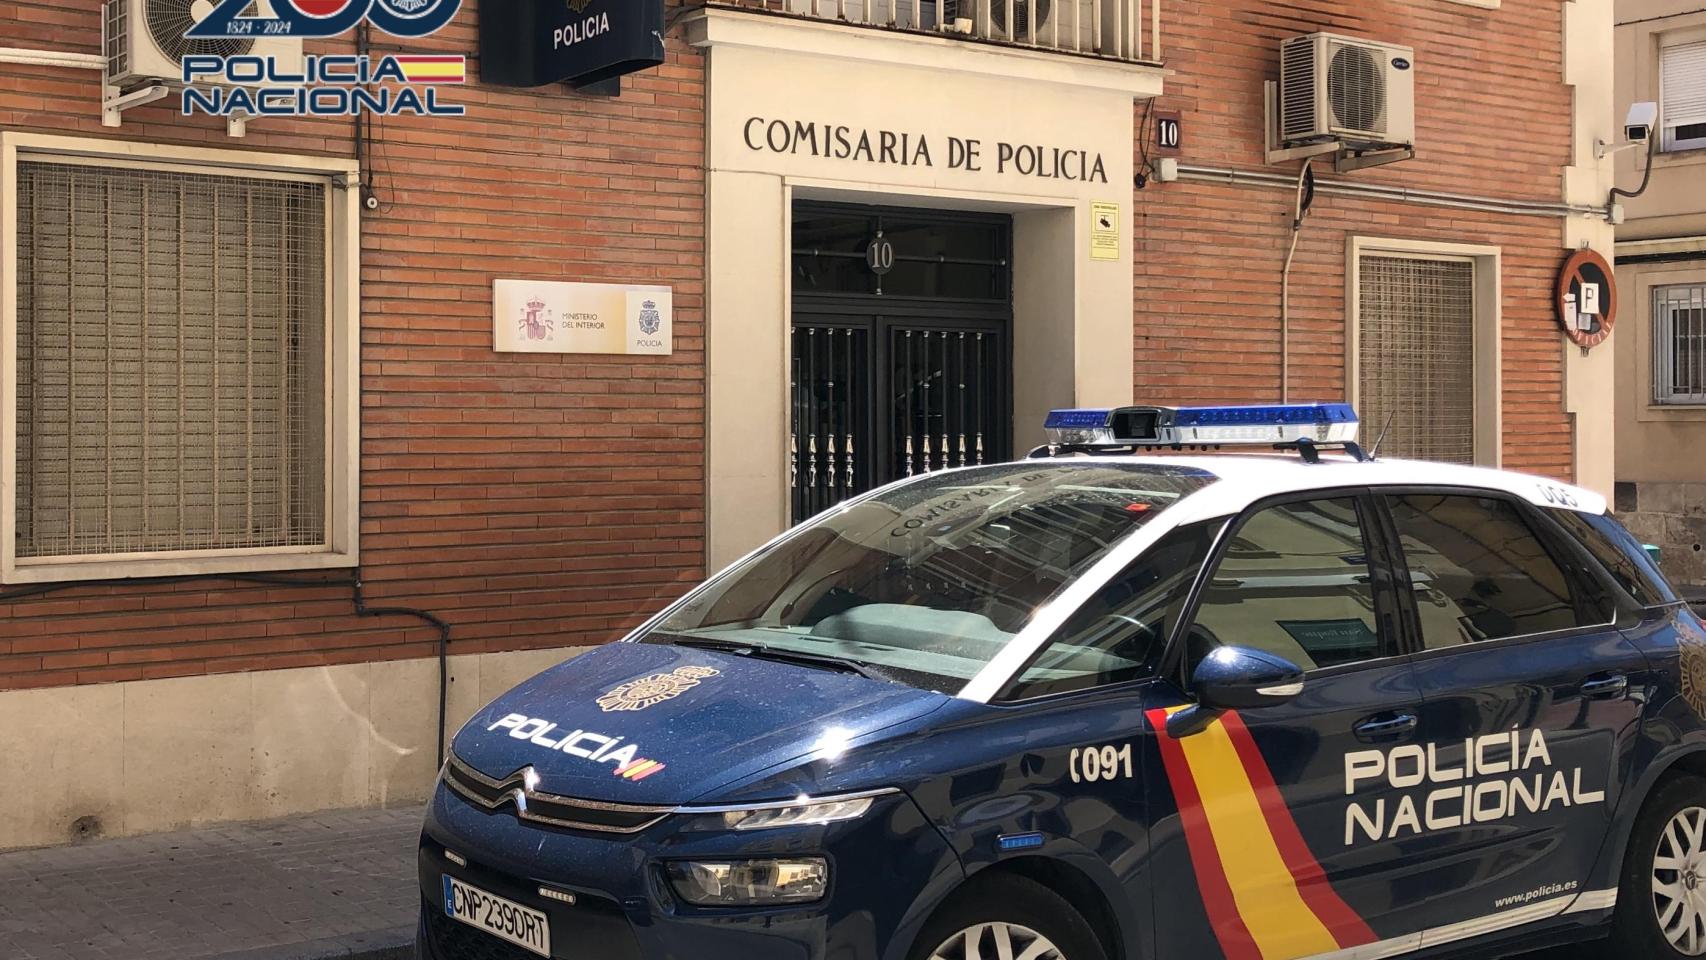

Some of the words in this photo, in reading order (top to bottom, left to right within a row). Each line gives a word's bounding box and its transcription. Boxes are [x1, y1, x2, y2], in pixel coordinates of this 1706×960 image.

[553, 11, 610, 50] POLICIA
[1159, 120, 1178, 147] 10
[743, 116, 933, 167] COMISARIA
[947, 136, 981, 172] DE
[997, 142, 1108, 184] POLICIA
[871, 242, 892, 268] 10
[1585, 287, 1594, 309] P
[562, 312, 598, 321] MINISTERIO
[562, 321, 574, 329] DEL
[575, 321, 605, 330] INTERIOR
[637, 339, 662, 348] POLICIA
[1082, 743, 1133, 782] 091
[1344, 722, 1551, 795] POLICÍA
[1344, 767, 1605, 846] NACIONAL
[1494, 880, 1578, 908] www.policia.es
